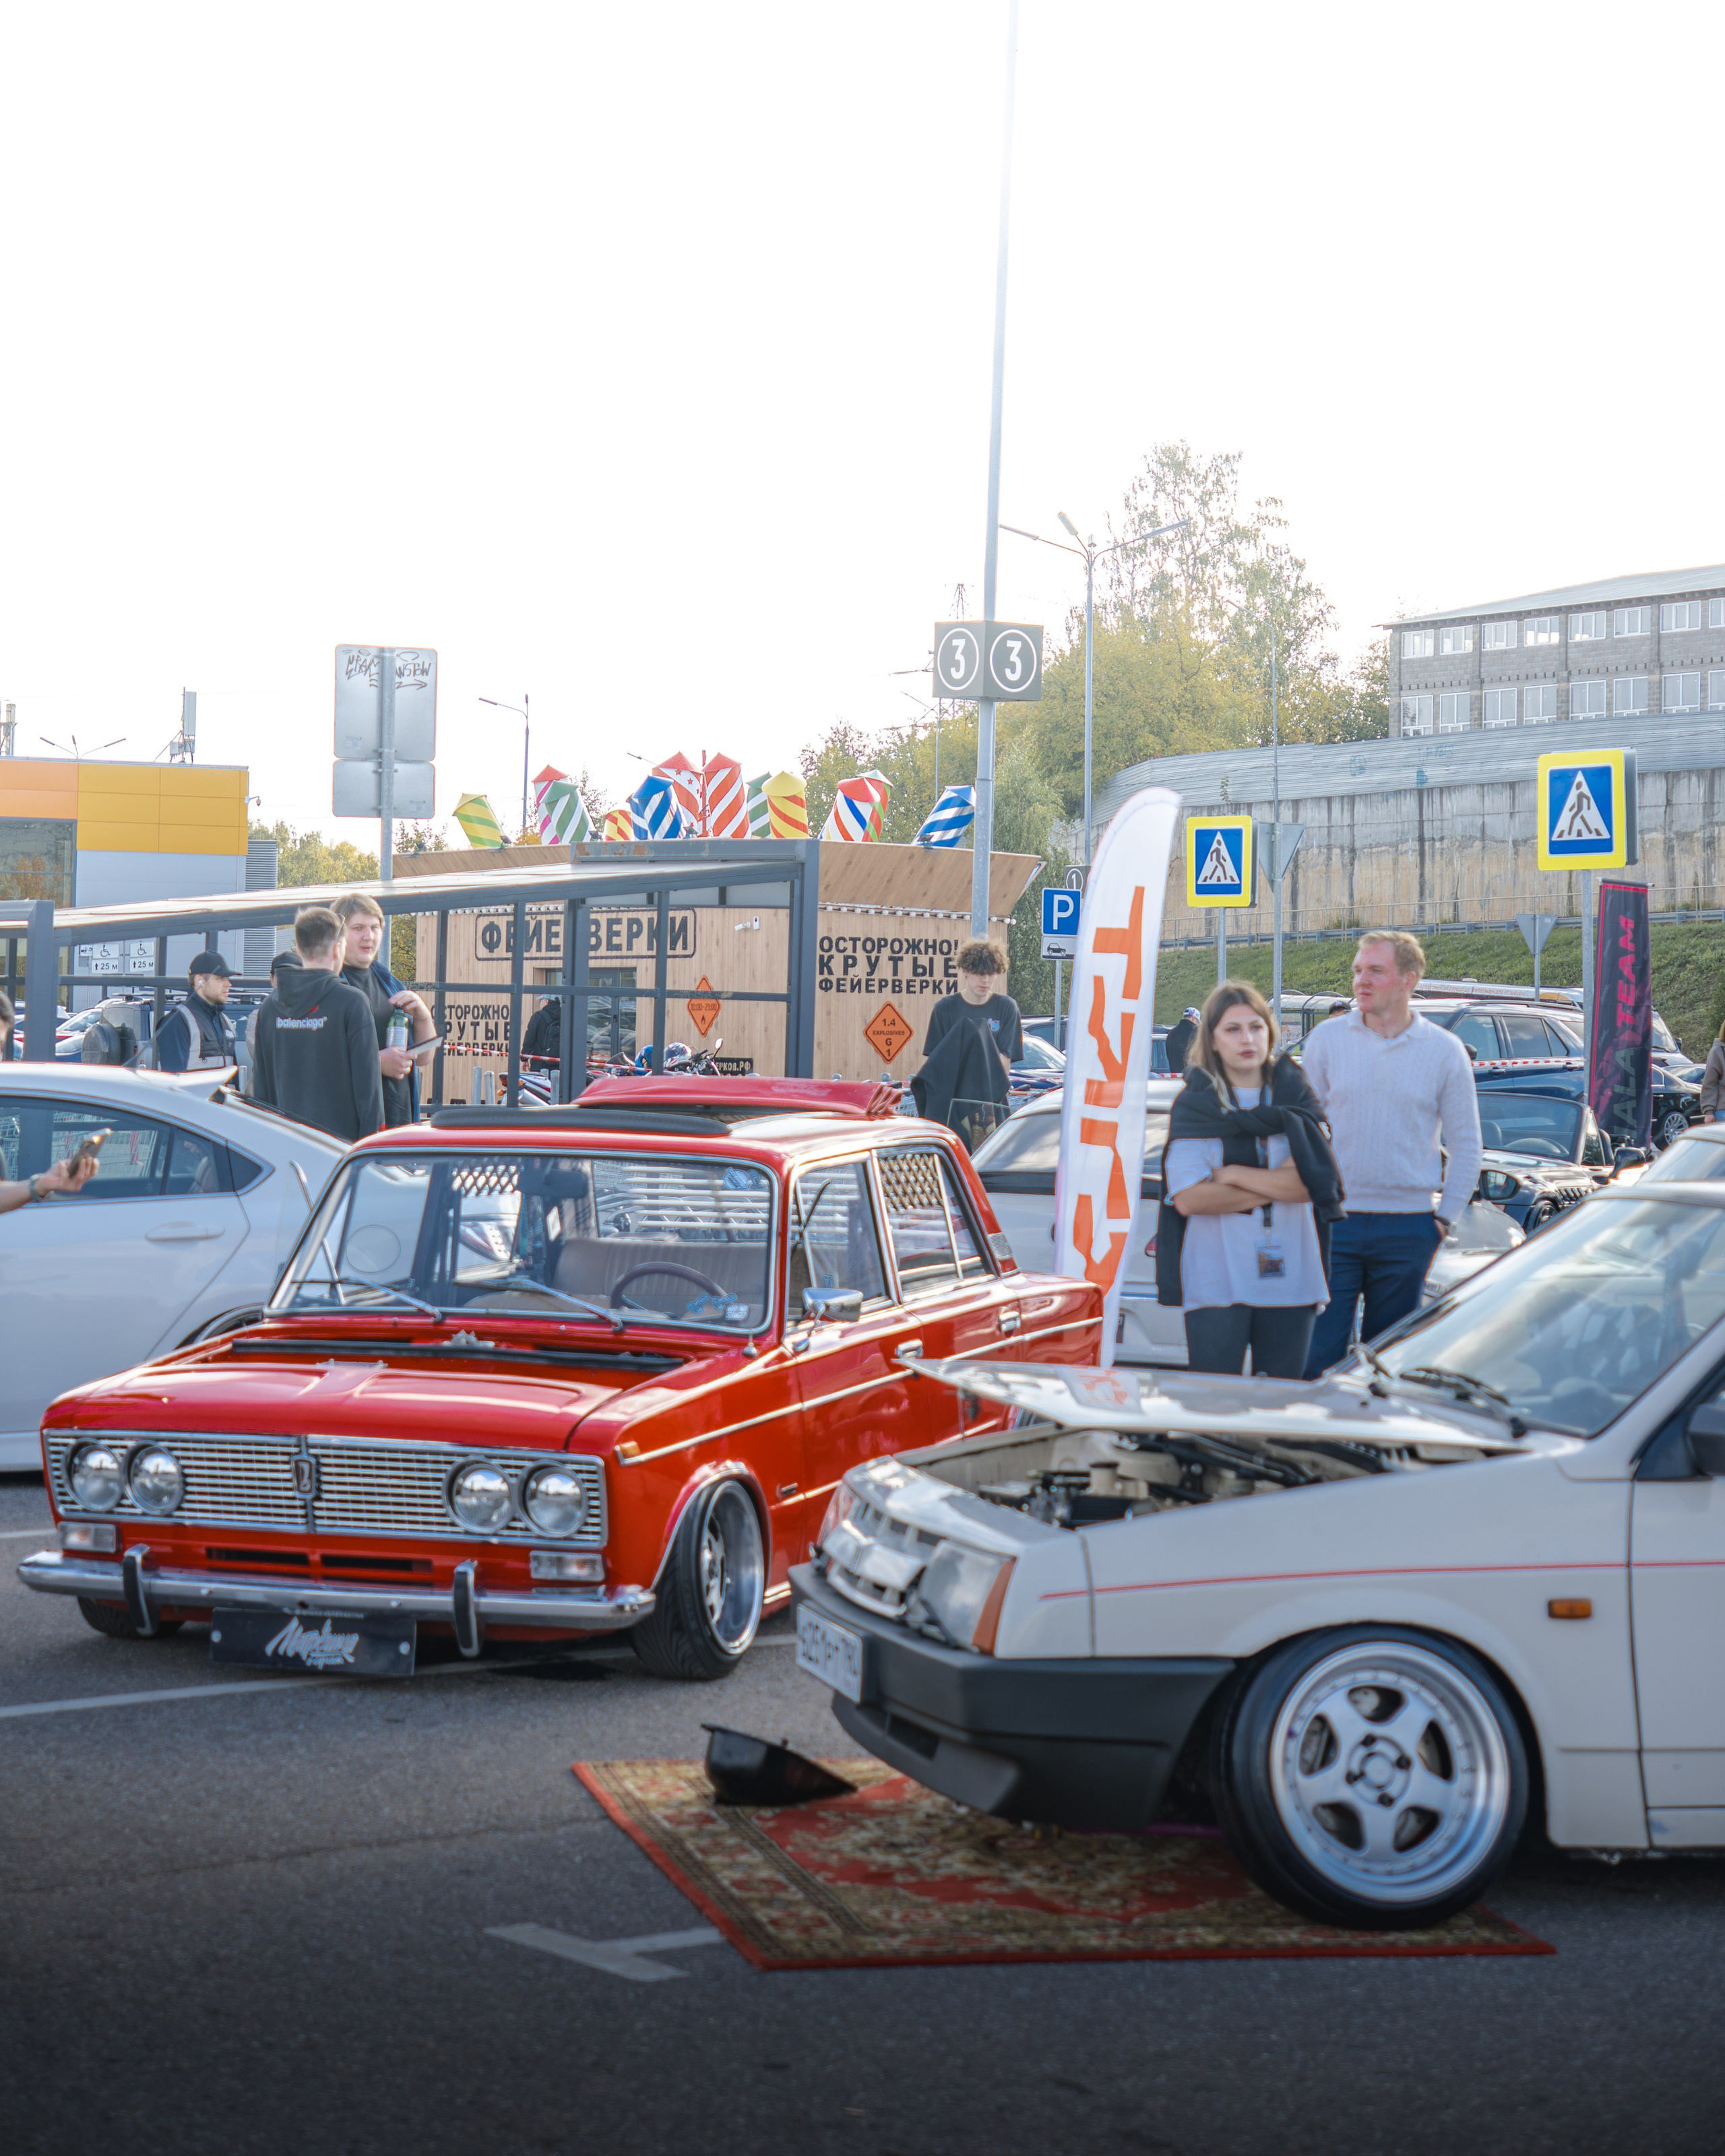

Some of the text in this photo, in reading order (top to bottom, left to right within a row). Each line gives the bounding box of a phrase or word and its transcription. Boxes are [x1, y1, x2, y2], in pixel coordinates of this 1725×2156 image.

[950, 638, 966, 680] 3
[1005, 639, 1022, 682] 3
[1053, 894, 1074, 930] P
[481, 916, 688, 953] ФЕЙЕВЕРКИ
[819, 936, 959, 956] ОСТОРОЖНО!
[819, 954, 958, 978] КРУТЫЕ
[1617, 915, 1637, 1028] TEAM
[819, 974, 958, 994] ФЕЙЕРВЕРКИ
[445, 1021, 511, 1041] РУТЫЕ
[882, 1018, 896, 1026] 1.4
[885, 1038, 892, 1046] G
[886, 1048, 891, 1056] 1
